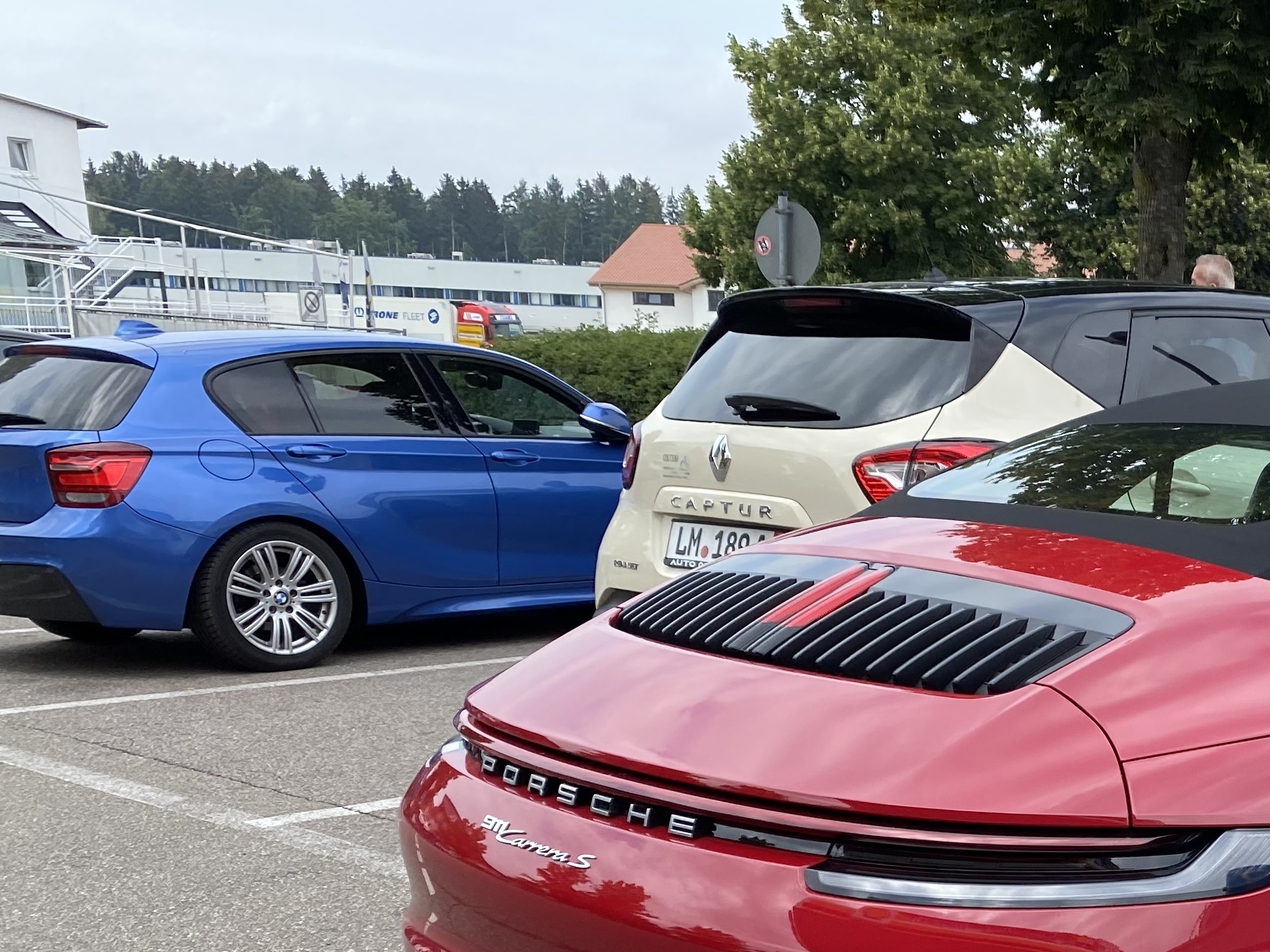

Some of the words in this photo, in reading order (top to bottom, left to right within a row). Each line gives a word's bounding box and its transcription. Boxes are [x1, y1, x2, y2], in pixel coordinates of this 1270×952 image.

[402, 311, 425, 321] FLEET
[670, 496, 773, 520] CAPTUR
[674, 526, 703, 558] LM
[670, 558, 696, 568] AUTO
[481, 754, 697, 838] PORSCHE
[480, 814, 510, 834] 911
[495, 829, 571, 863] Carrera
[567, 853, 597, 869] S
